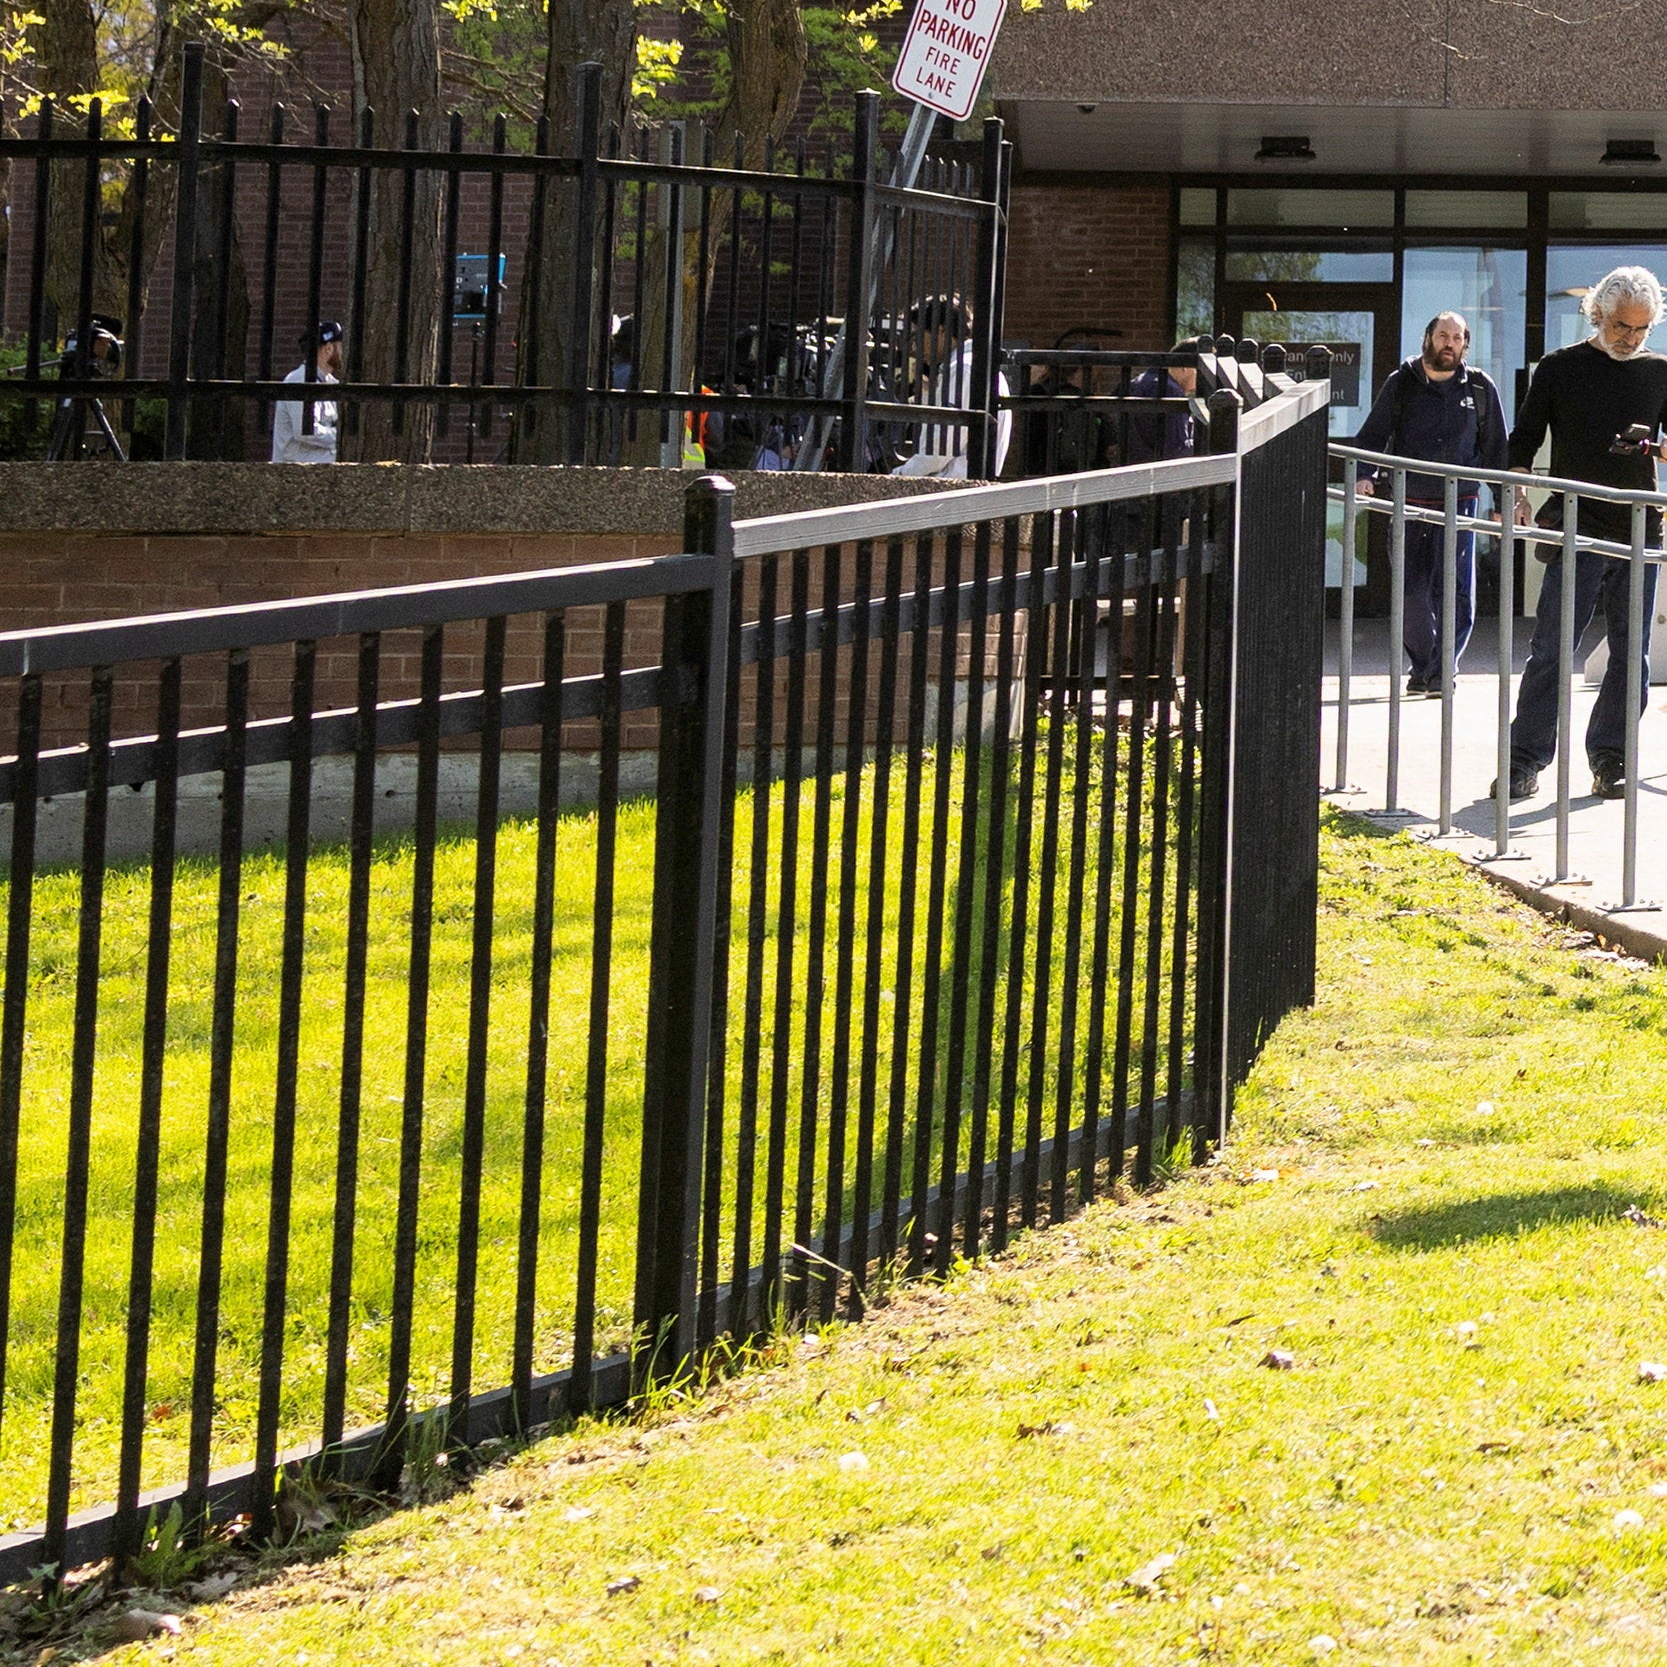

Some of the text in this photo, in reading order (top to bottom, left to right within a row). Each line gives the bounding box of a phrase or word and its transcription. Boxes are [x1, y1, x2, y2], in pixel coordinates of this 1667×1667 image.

[917, 9, 986, 60] PARKING
[925, 46, 961, 75] FIRE
[915, 66, 956, 98] LANE
